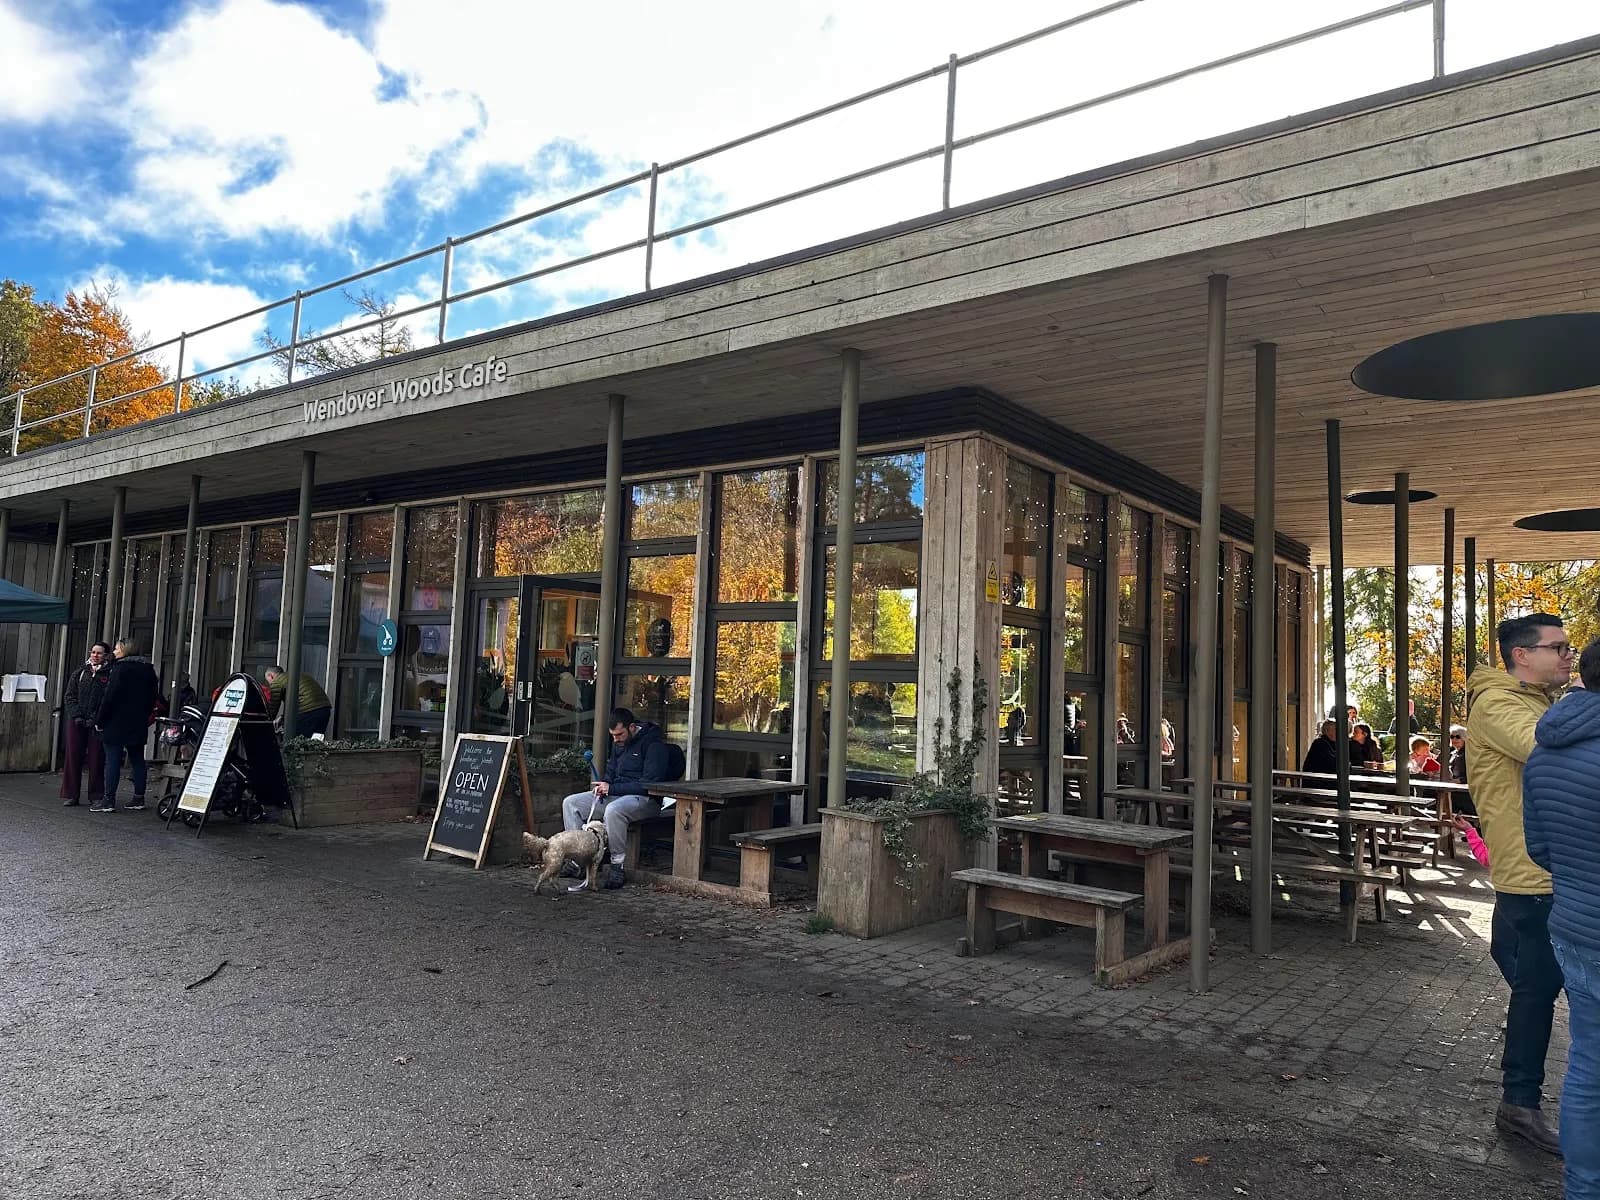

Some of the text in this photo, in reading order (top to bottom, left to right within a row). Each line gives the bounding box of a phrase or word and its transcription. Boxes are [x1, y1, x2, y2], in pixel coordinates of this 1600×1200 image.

[303, 355, 508, 423] Wendover Woods Cafe
[455, 772, 489, 791] OPEN
